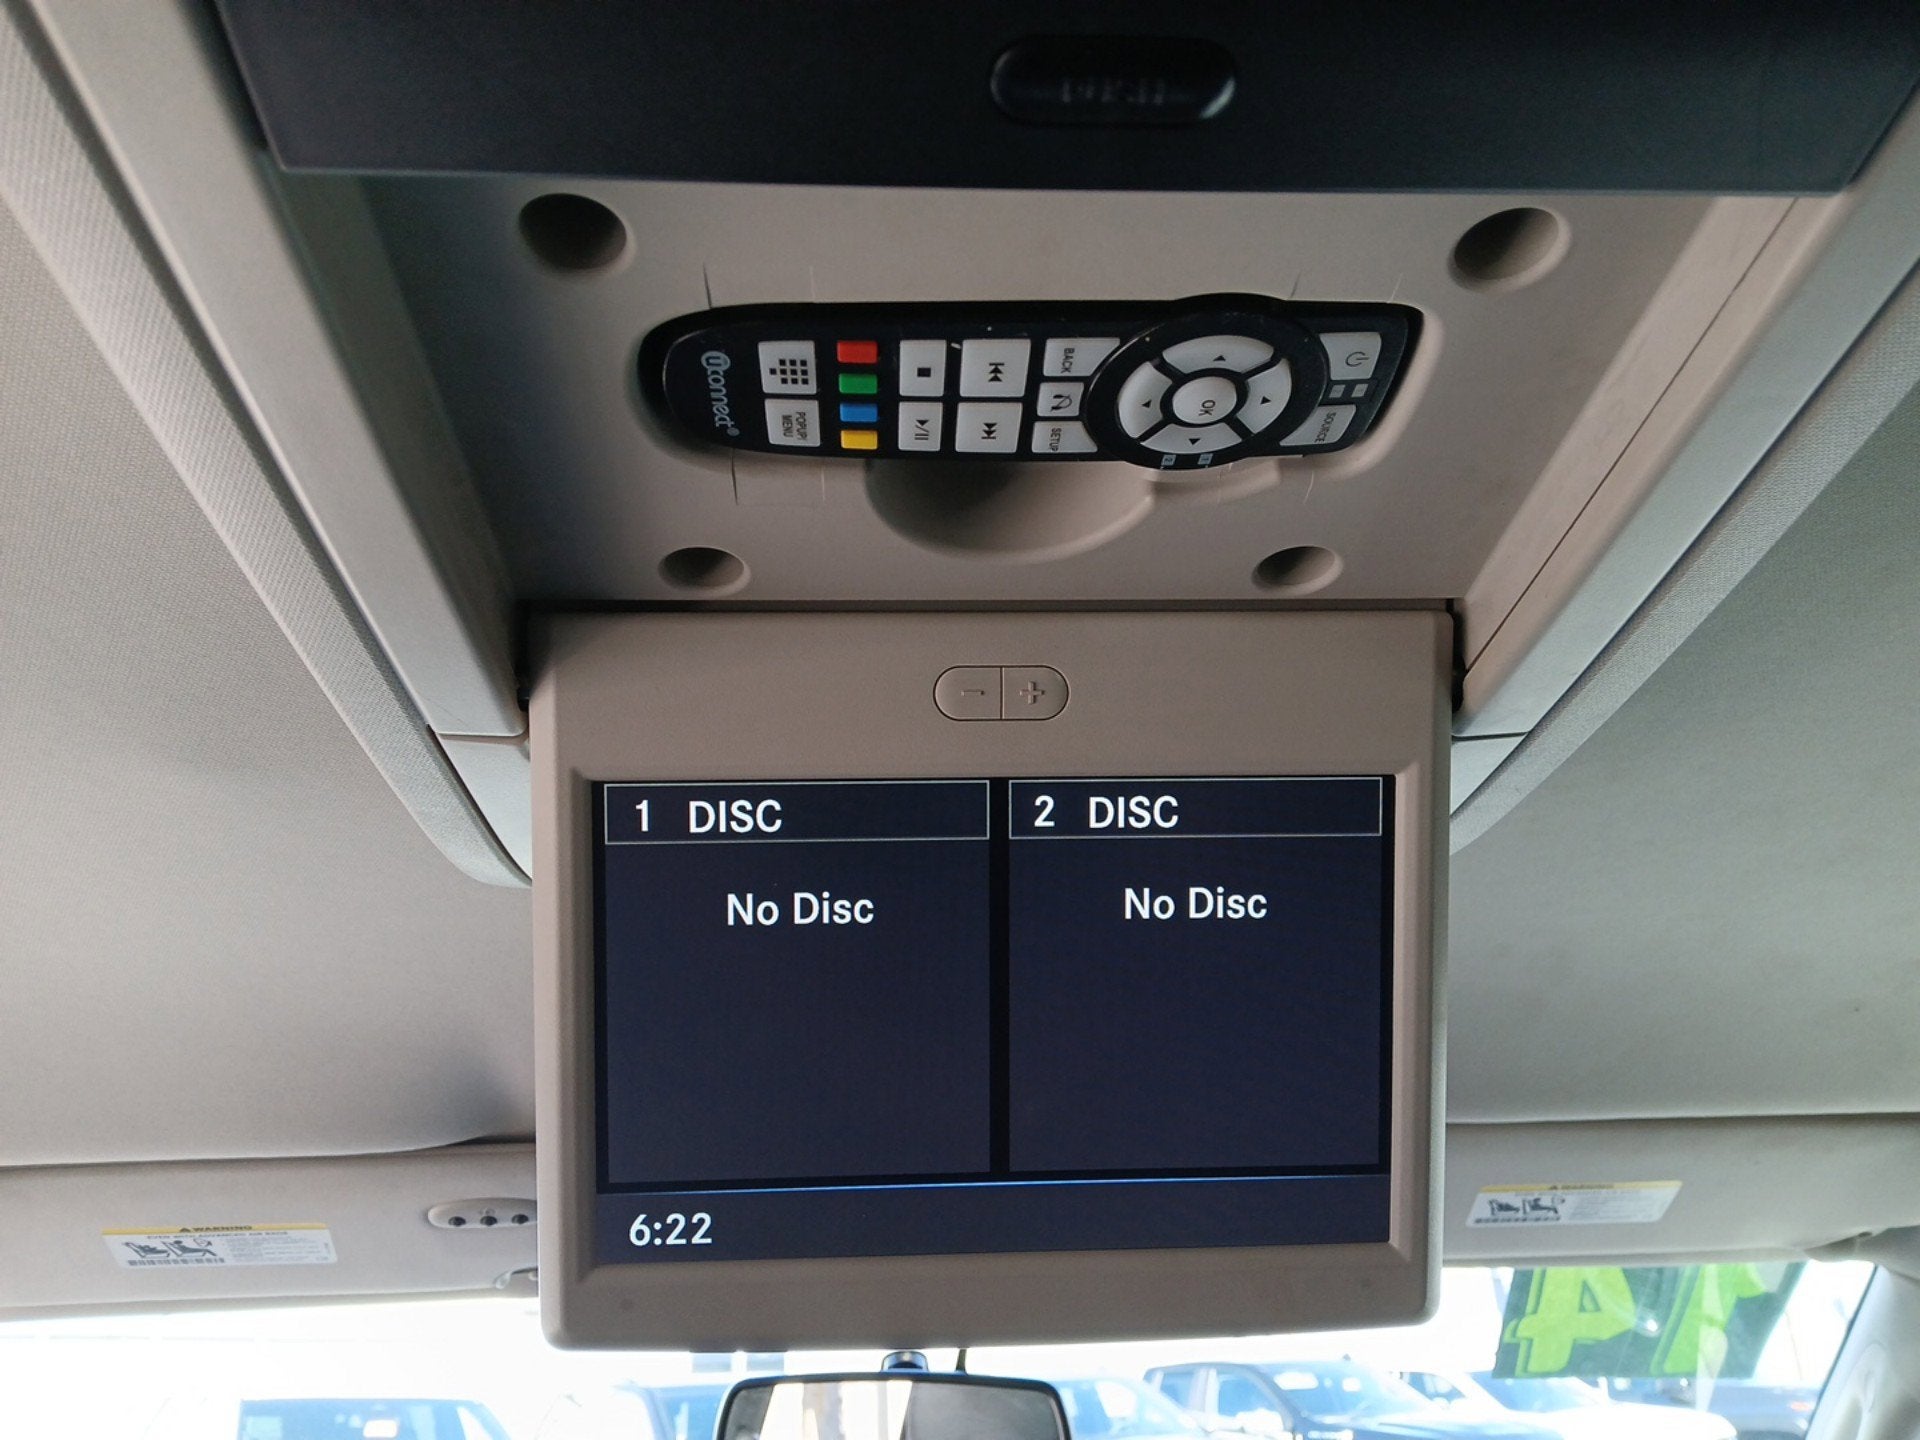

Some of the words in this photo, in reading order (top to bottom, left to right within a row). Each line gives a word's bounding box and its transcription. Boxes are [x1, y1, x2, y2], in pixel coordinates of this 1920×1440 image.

[1061, 347, 1075, 373] BACK
[1199, 399, 1216, 417] OK
[782, 414, 793, 438] MENU
[1050, 427, 1062, 452] SETUP
[1315, 411, 1337, 443] SOURCE
[635, 799, 649, 832] 1
[688, 798, 782, 834] DISC
[1034, 794, 1055, 828] 2
[1088, 795, 1179, 829] DISC
[727, 892, 780, 926] No
[793, 891, 874, 925] Disc
[1124, 887, 1176, 920] No
[1188, 886, 1268, 920] Disc
[628, 1212, 713, 1247] 6:22
